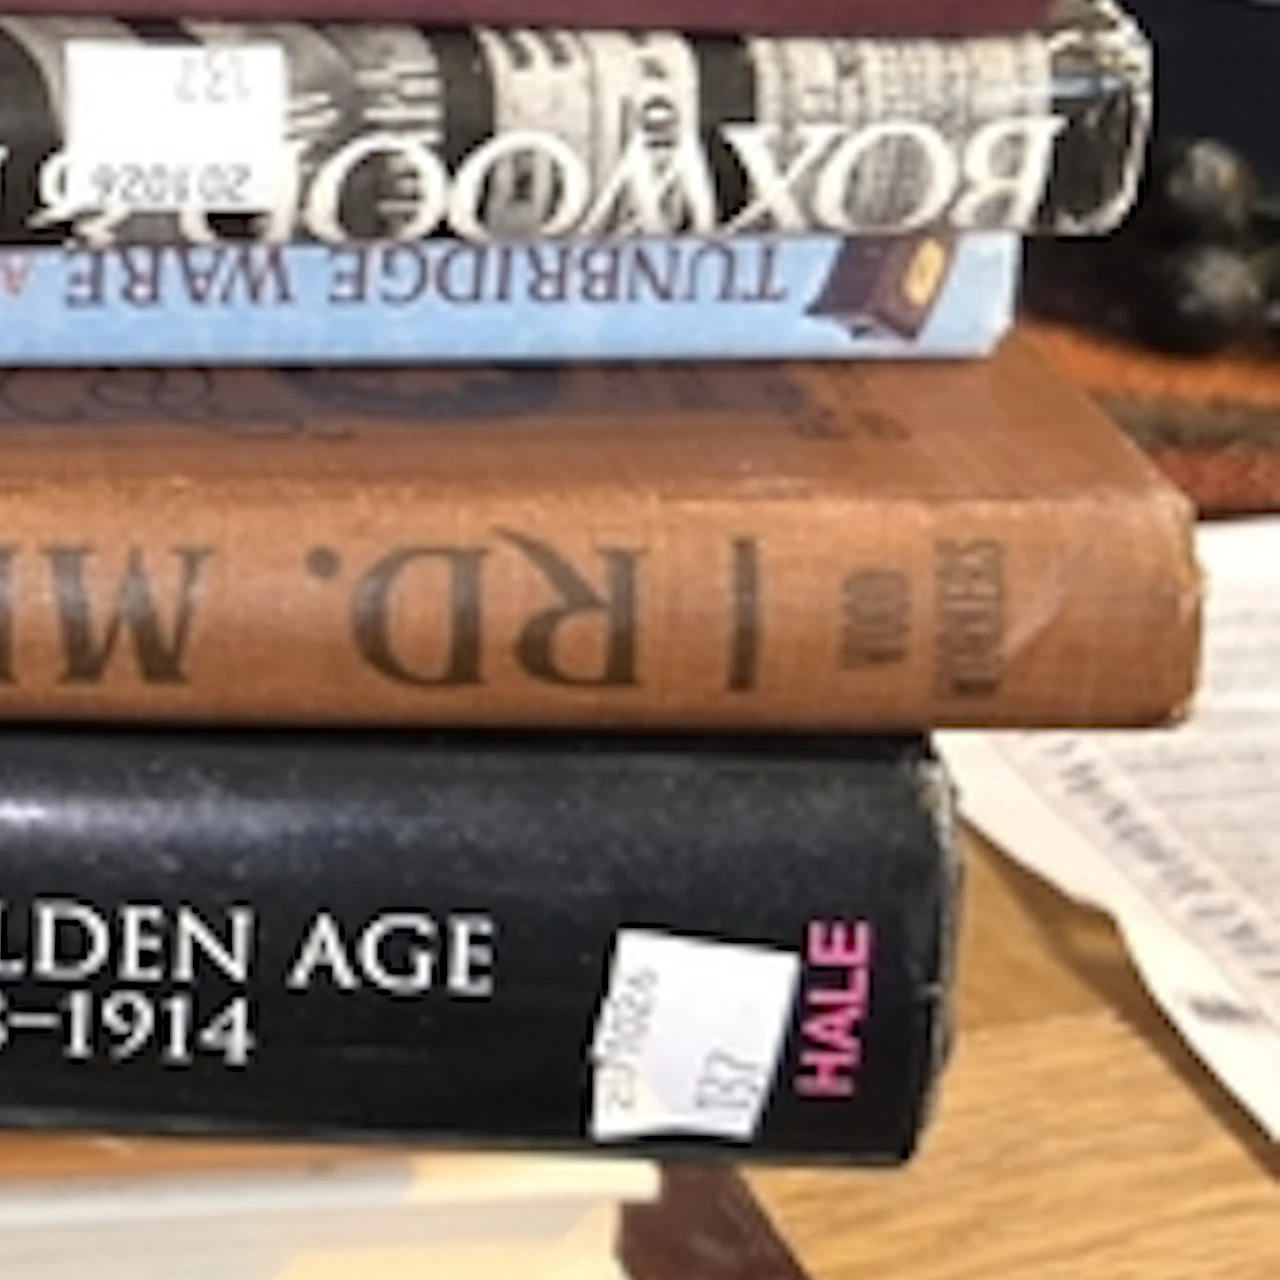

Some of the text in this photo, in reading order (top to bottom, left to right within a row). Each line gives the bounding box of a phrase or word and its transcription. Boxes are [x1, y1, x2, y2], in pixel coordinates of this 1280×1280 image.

[65, 242, 790, 310] TUNBRIDGE WARE
[308, 529, 647, 690] RD.
[285, 912, 496, 997] AGE
[793, 918, 871, 1098] HALE
